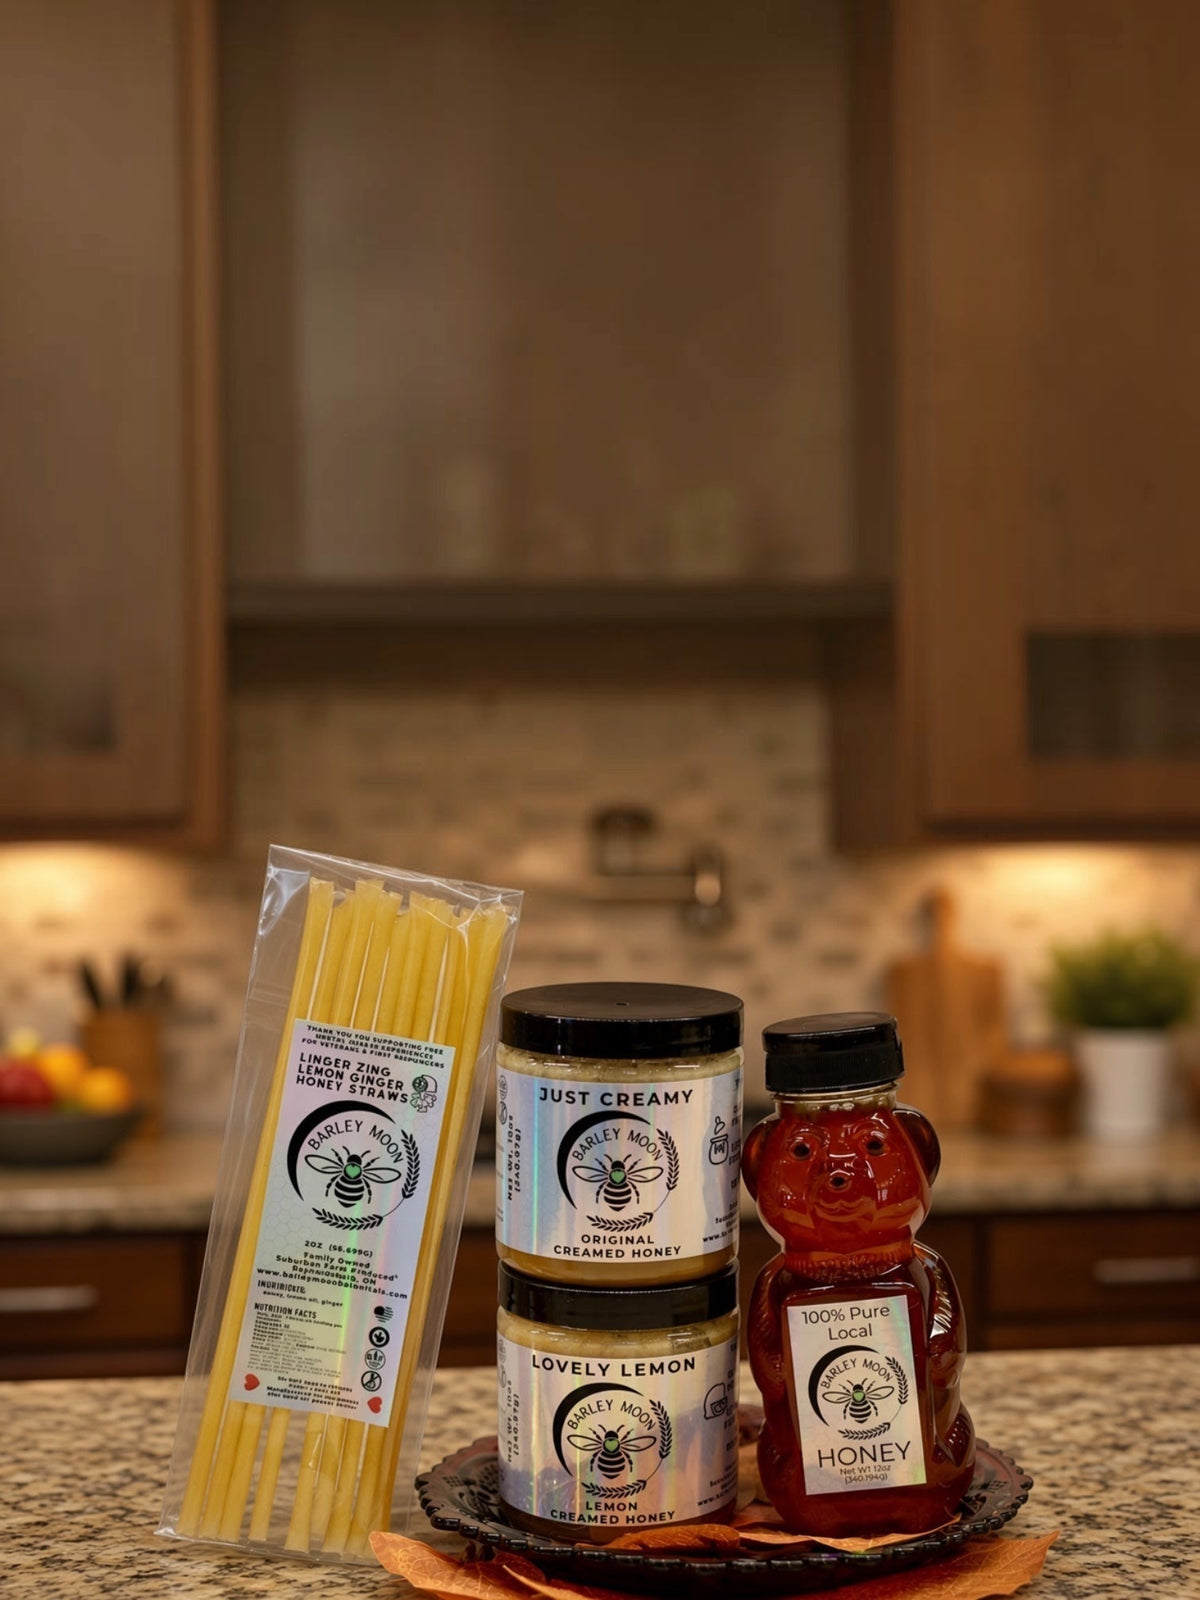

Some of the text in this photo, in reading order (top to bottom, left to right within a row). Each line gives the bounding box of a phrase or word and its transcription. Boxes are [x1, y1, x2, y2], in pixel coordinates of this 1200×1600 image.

[306, 1024, 333, 1036] THANK
[336, 1030, 352, 1038] YOU
[355, 1033, 370, 1041] YOU
[300, 1052, 391, 1077] LINGER ZING
[298, 1064, 404, 1091] LEMON GINGER
[296, 1075, 408, 1104] HONEY STRAWS
[539, 1087, 693, 1106] JUST CREAMY
[308, 1120, 404, 1164] BARLEY MOON
[572, 1128, 663, 1162] BARLEY MOON
[581, 1234, 654, 1245] ORIGINAL
[304, 1252, 335, 1264] Family
[554, 1245, 682, 1258] CREAMED HONEY
[276, 1255, 321, 1268] Suburban
[294, 1308, 317, 1320] FACTS
[802, 1306, 890, 1324] 100% Pure
[828, 1324, 873, 1341] Local
[532, 1354, 696, 1377] LOVELY LEMON
[820, 1358, 894, 1389] BARLEY MOON
[567, 1400, 656, 1431] BARLEY MOON
[818, 1441, 911, 1468] HONEY
[840, 1468, 856, 1476] Net
[874, 1464, 891, 1472] 12oz
[586, 1502, 638, 1511] LEMON
[550, 1510, 676, 1524] CREAMED HONEY
